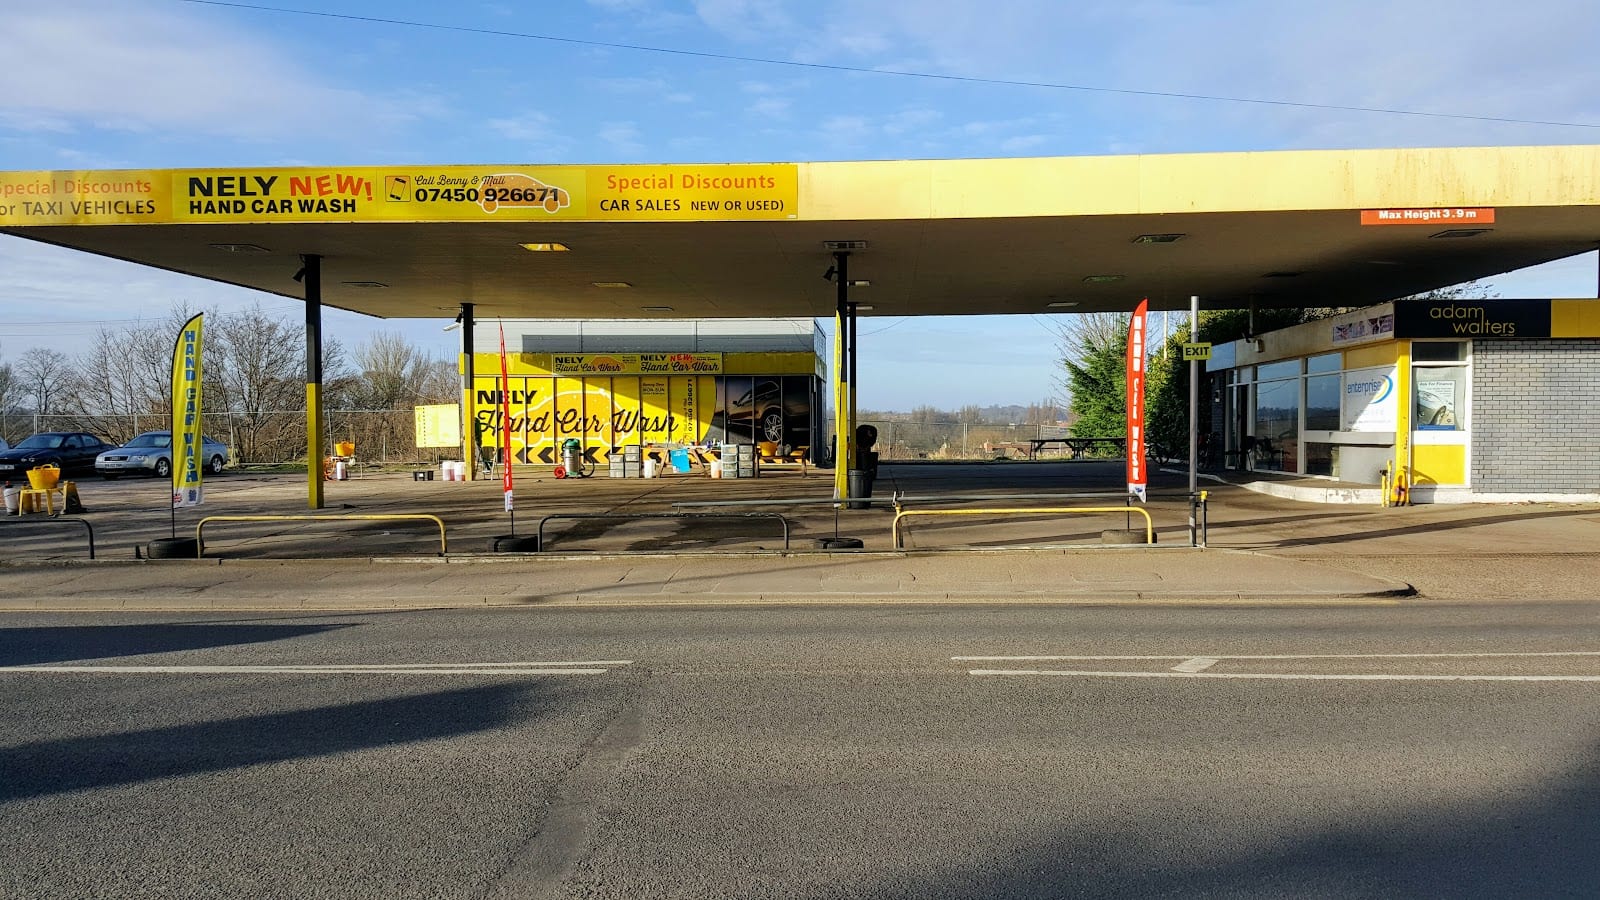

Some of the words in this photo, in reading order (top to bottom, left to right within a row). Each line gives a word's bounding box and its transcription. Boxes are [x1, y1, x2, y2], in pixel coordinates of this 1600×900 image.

[189, 176, 279, 197] NELY
[289, 174, 373, 201] NEW!
[414, 175, 434, 185] Call
[437, 174, 468, 187] Benny
[471, 176, 479, 184] &
[607, 174, 674, 192] Special
[682, 174, 776, 189] Discounts
[0, 179, 56, 198] pecial
[64, 179, 152, 194] Discounts
[415, 188, 479, 202] 07450
[484, 188, 559, 202] 926671
[22, 201, 63, 216] TAXI
[70, 199, 156, 215] VEHICLES
[189, 200, 246, 214] HAND
[251, 199, 293, 213] CAR
[298, 198, 356, 213] WASH
[600, 199, 630, 211] CAR
[635, 199, 681, 211] SALES
[691, 200, 720, 211] NEW
[724, 200, 742, 211] OR
[746, 199, 784, 212] USED)
[1379, 210, 1401, 219] Max
[1404, 209, 1441, 220] Height
[1430, 304, 1484, 319] adam
[1453, 319, 1516, 334] walters
[184, 330, 196, 381] HAND
[1185, 347, 1210, 356] EXIT
[555, 356, 584, 364] NELY
[640, 361, 669, 373] Hand
[671, 361, 690, 372] Car
[691, 361, 719, 372] Wash
[185, 388, 197, 426] CAR
[555, 408, 604, 433] Car
[611, 408, 680, 433] Wash
[184, 432, 198, 482] WASH
